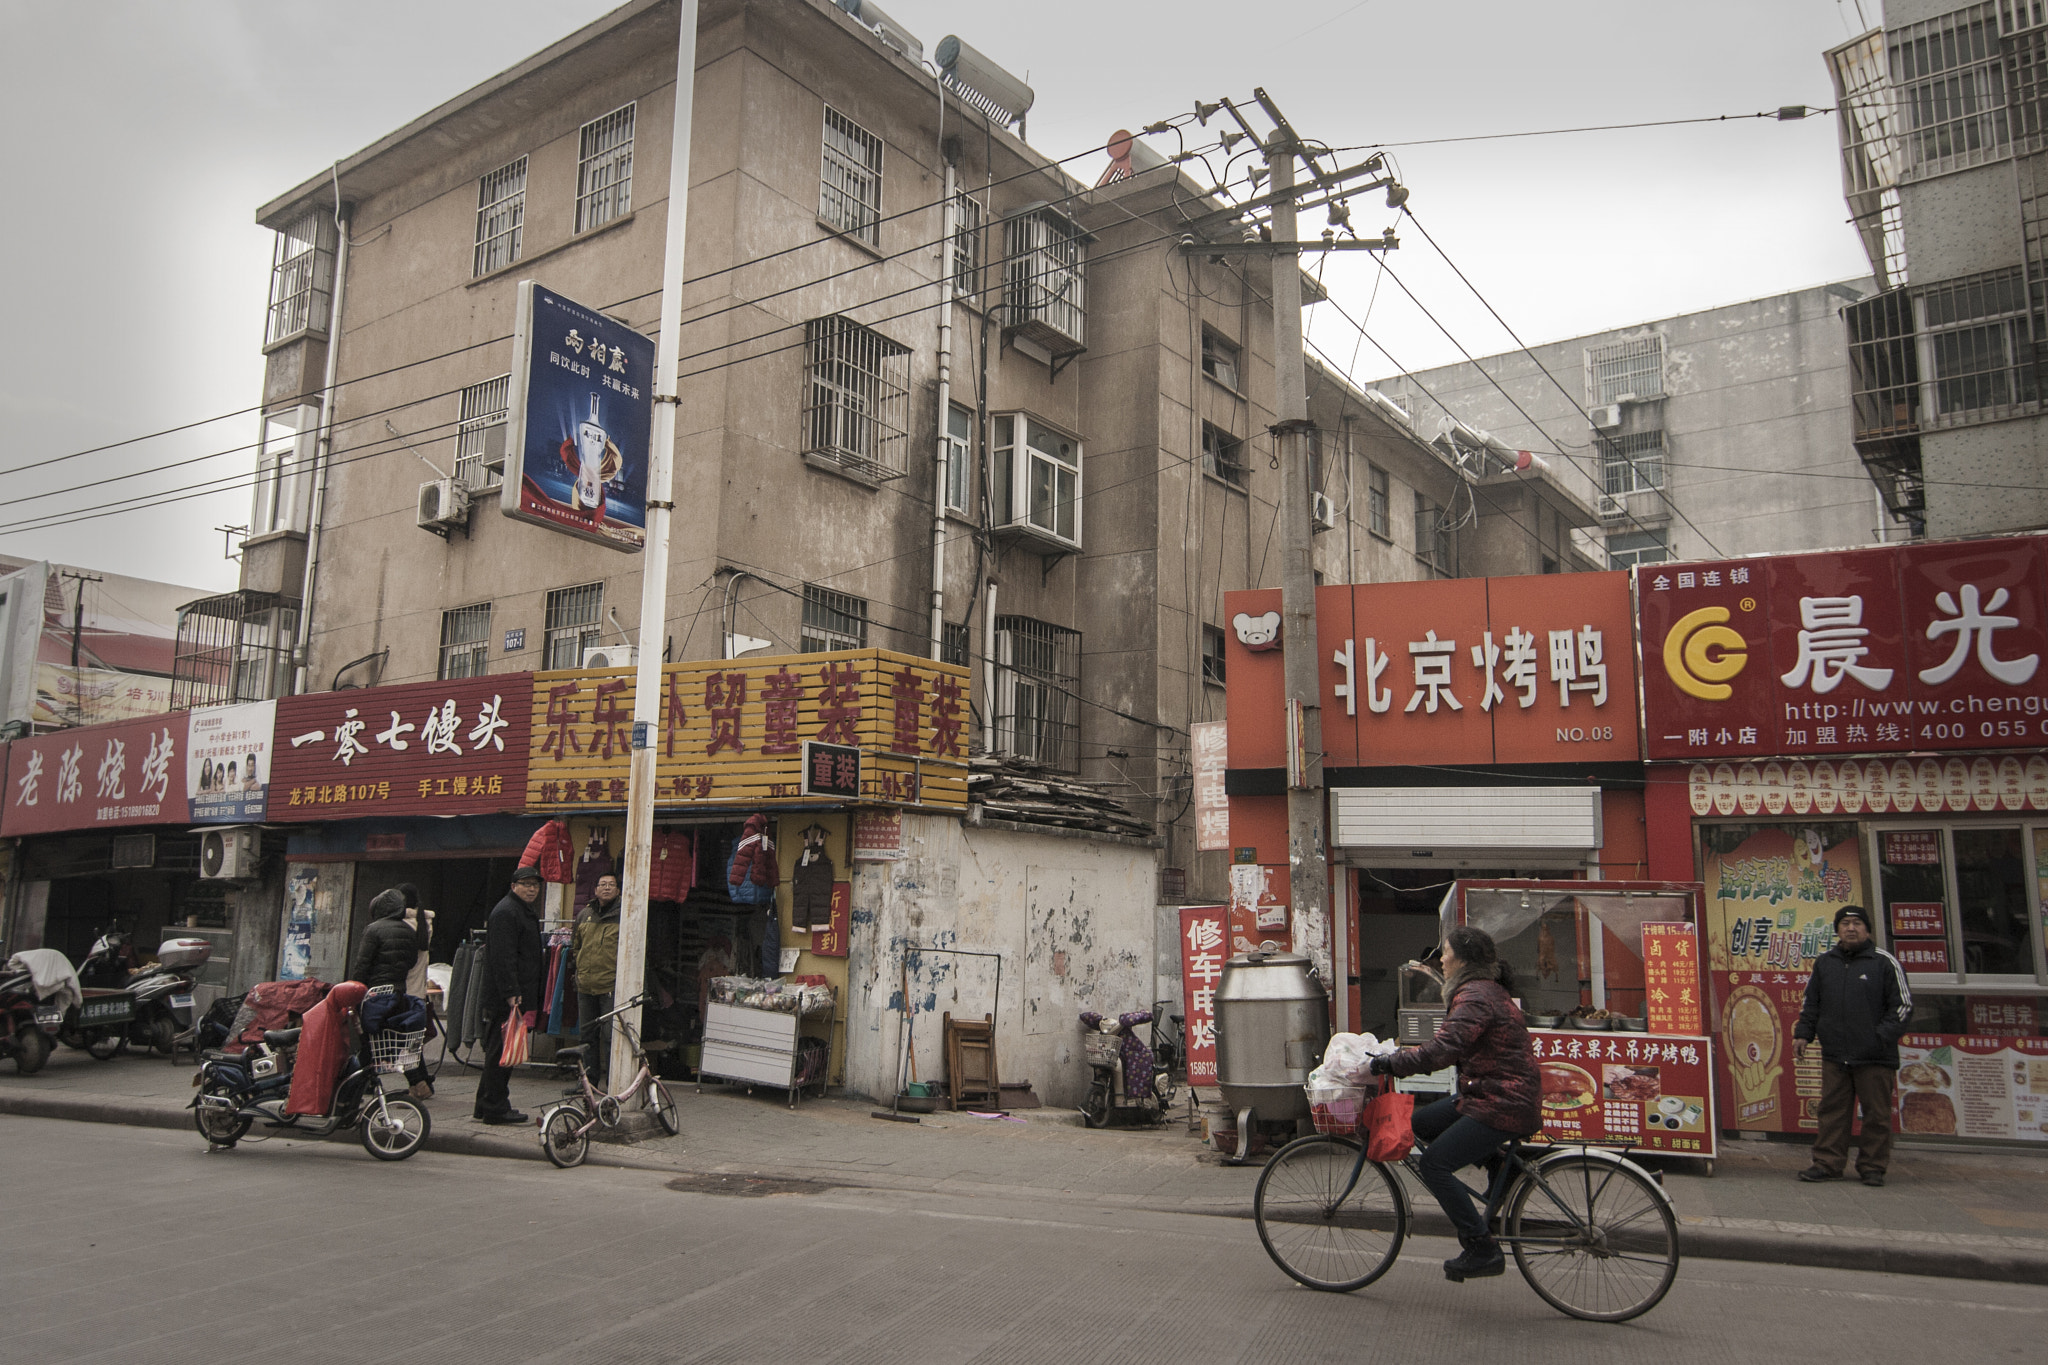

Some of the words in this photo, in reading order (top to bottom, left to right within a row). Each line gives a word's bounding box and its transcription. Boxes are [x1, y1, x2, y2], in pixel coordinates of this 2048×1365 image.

[550, 352, 590, 379] 同饮此时
[1652, 567, 1750, 591] 全国连锁
[1780, 584, 2039, 694] 晨光
[1333, 624, 1609, 716] 北京烤鸭
[890, 665, 962, 757] 童装
[291, 694, 509, 766] 一零七馒头
[1556, 727, 1613, 743] NO.08
[1663, 726, 1757, 746] 一附小店
[1920, 722, 1965, 740] 400
[1980, 720, 2026, 737] 055
[813, 751, 856, 789] 童装
[289, 781, 391, 806] 龙河北路107号
[418, 775, 503, 799] 手工馒头店
[540, 778, 625, 801] 批发零售
[1973, 1004, 2032, 1025] 饼已售完
